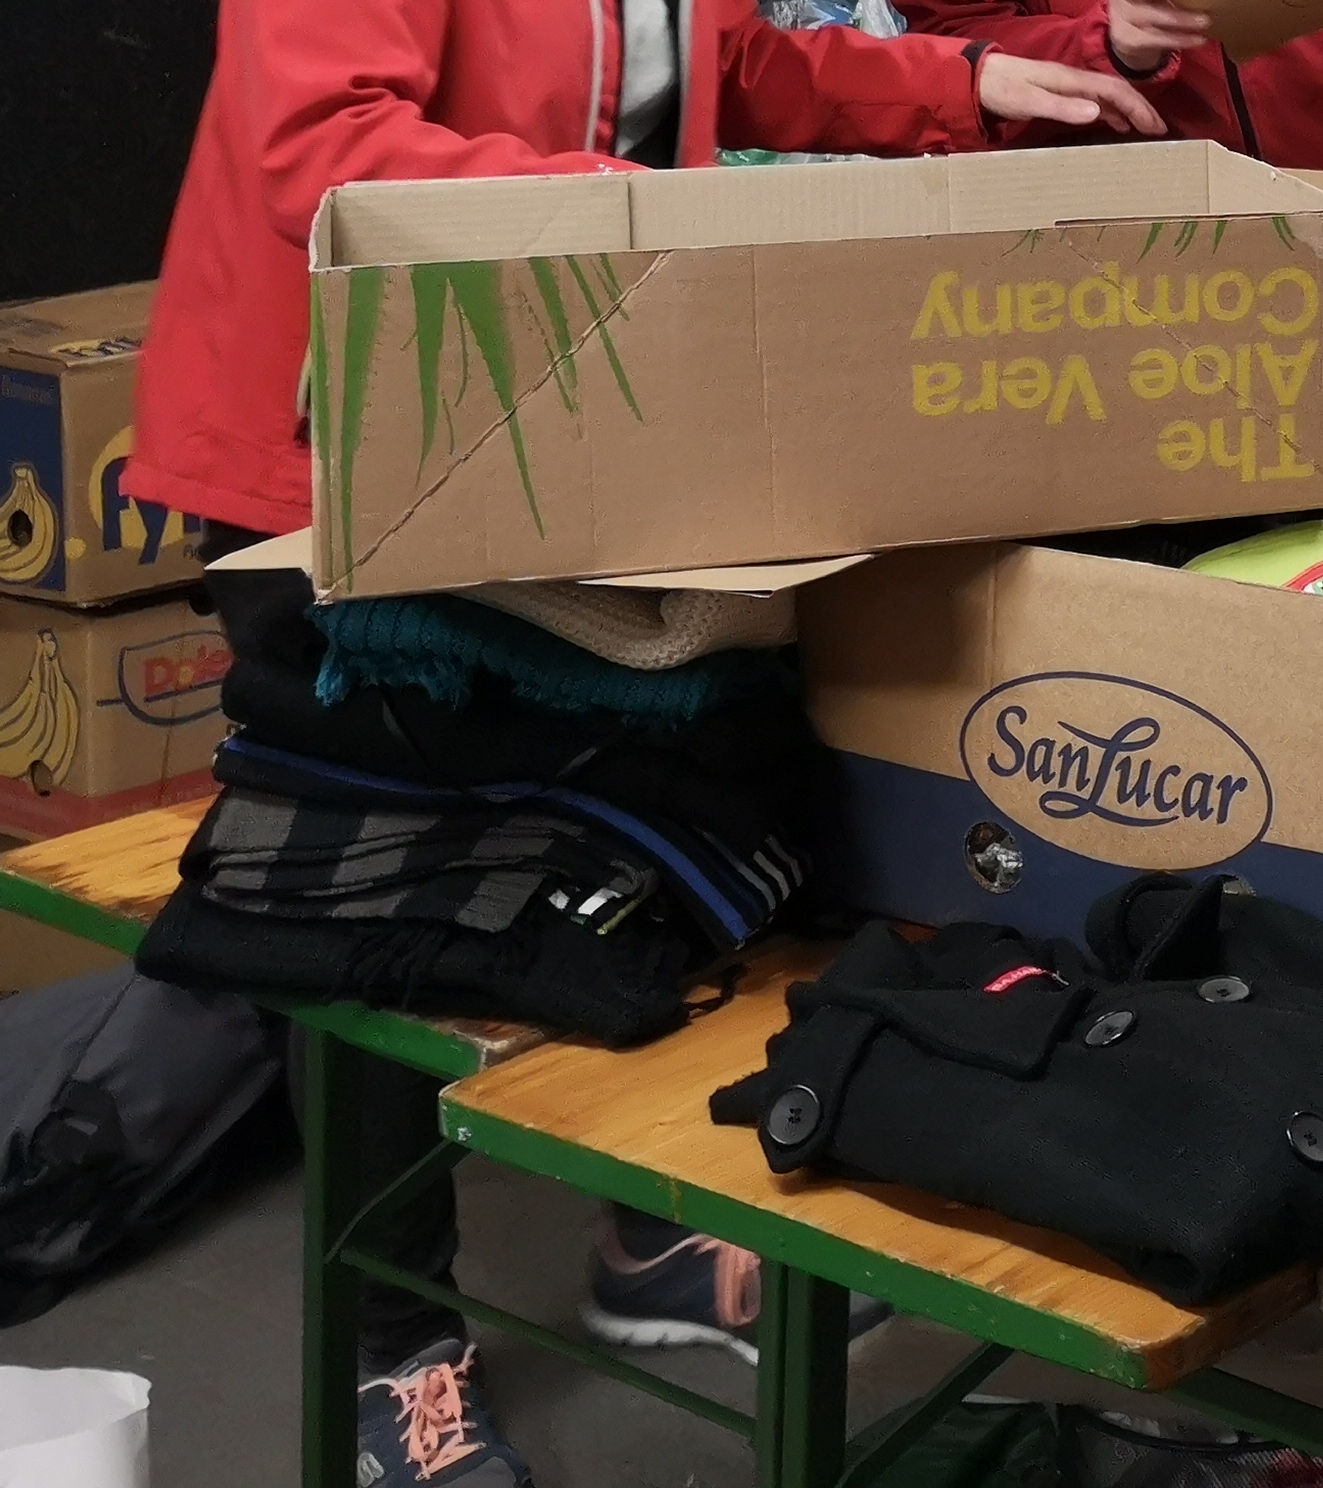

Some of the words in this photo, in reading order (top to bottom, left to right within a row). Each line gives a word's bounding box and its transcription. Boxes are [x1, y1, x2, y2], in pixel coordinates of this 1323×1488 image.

[911, 265, 1322, 343] Company
[910, 352, 1106, 426] Vera
[1128, 340, 1320, 409] Aloe
[1157, 414, 1318, 485] The
[143, 644, 234, 696] Dole
[987, 704, 1248, 829] SanLucar
